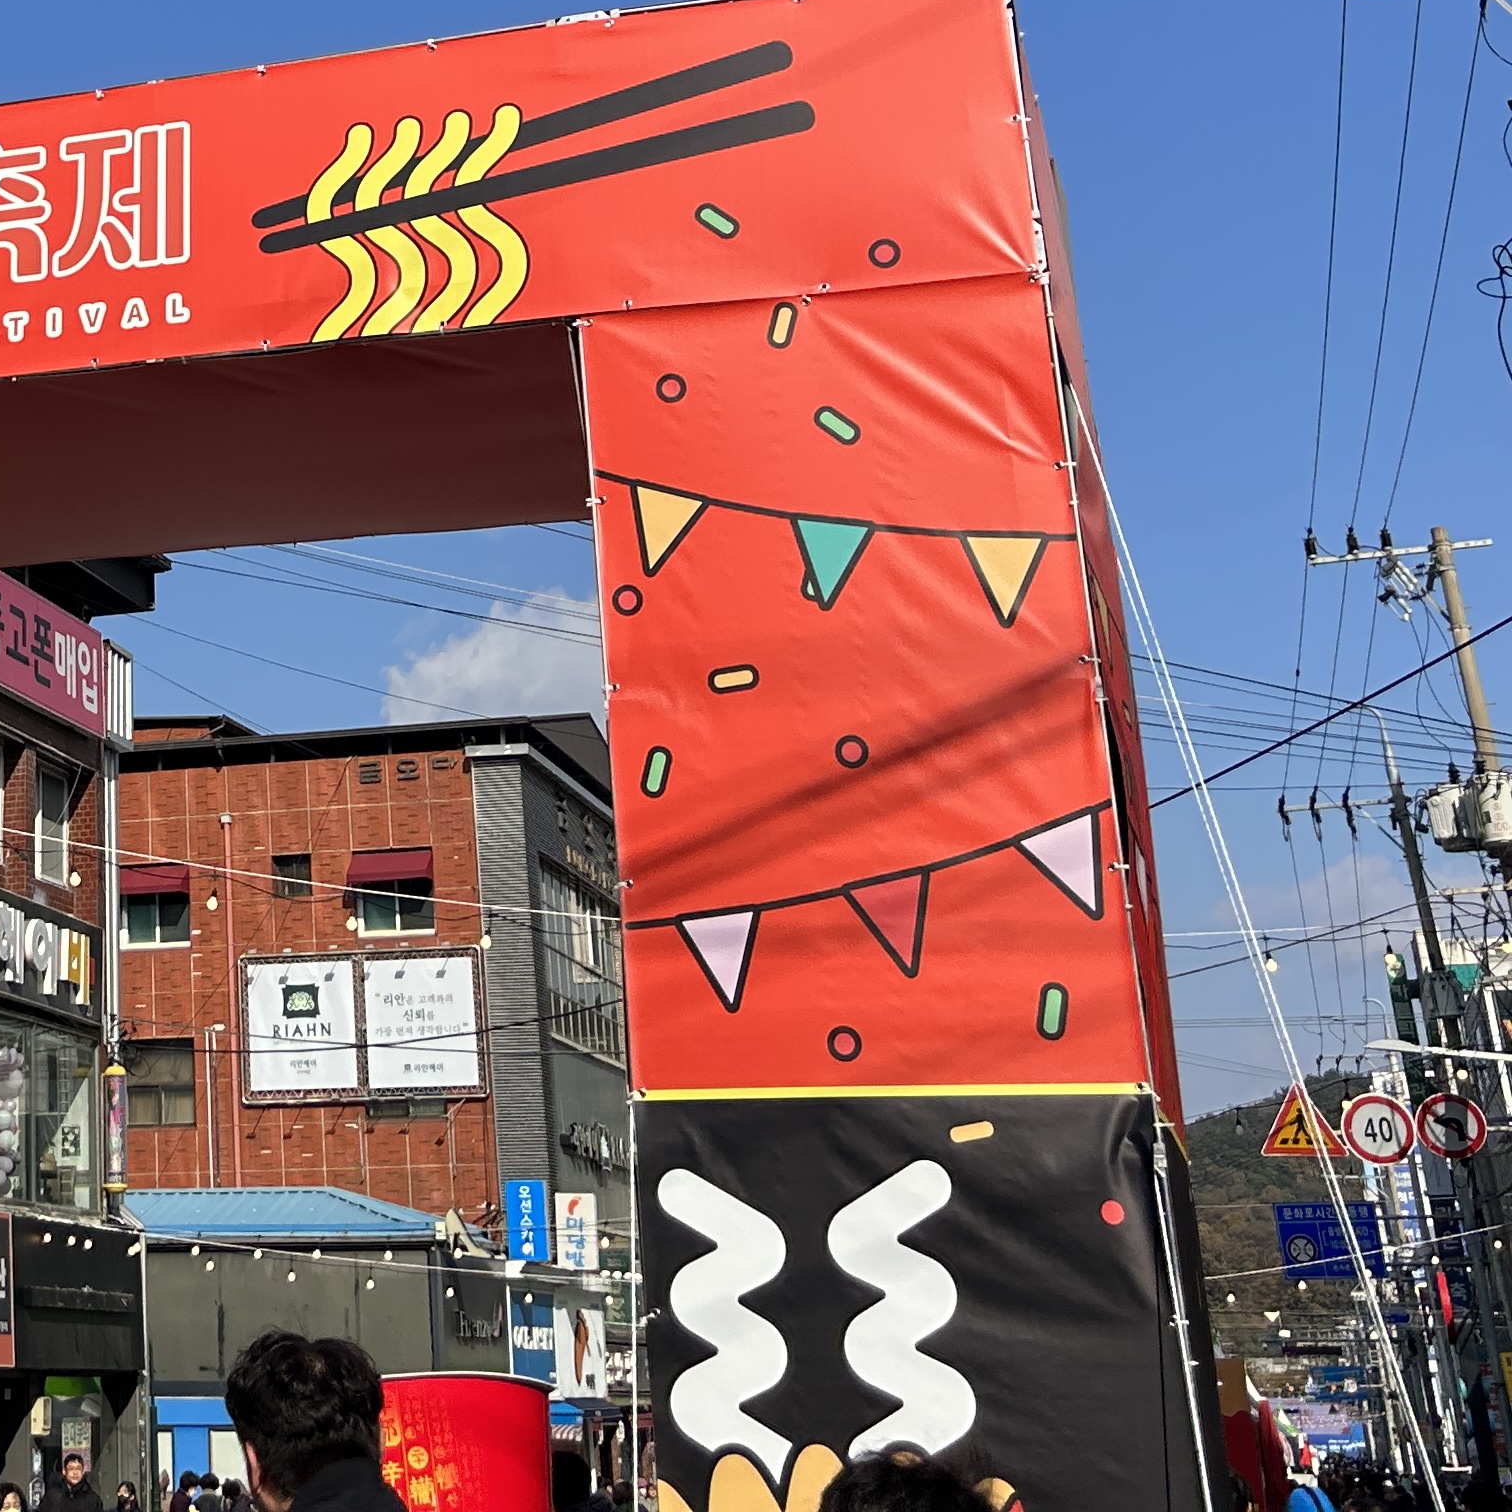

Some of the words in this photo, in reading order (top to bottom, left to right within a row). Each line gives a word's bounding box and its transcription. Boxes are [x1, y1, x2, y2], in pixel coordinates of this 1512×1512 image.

[273, 1023, 332, 1039] RIAHN
[1364, 1116, 1393, 1144] 40
[565, 1216, 586, 1268] 마당발
